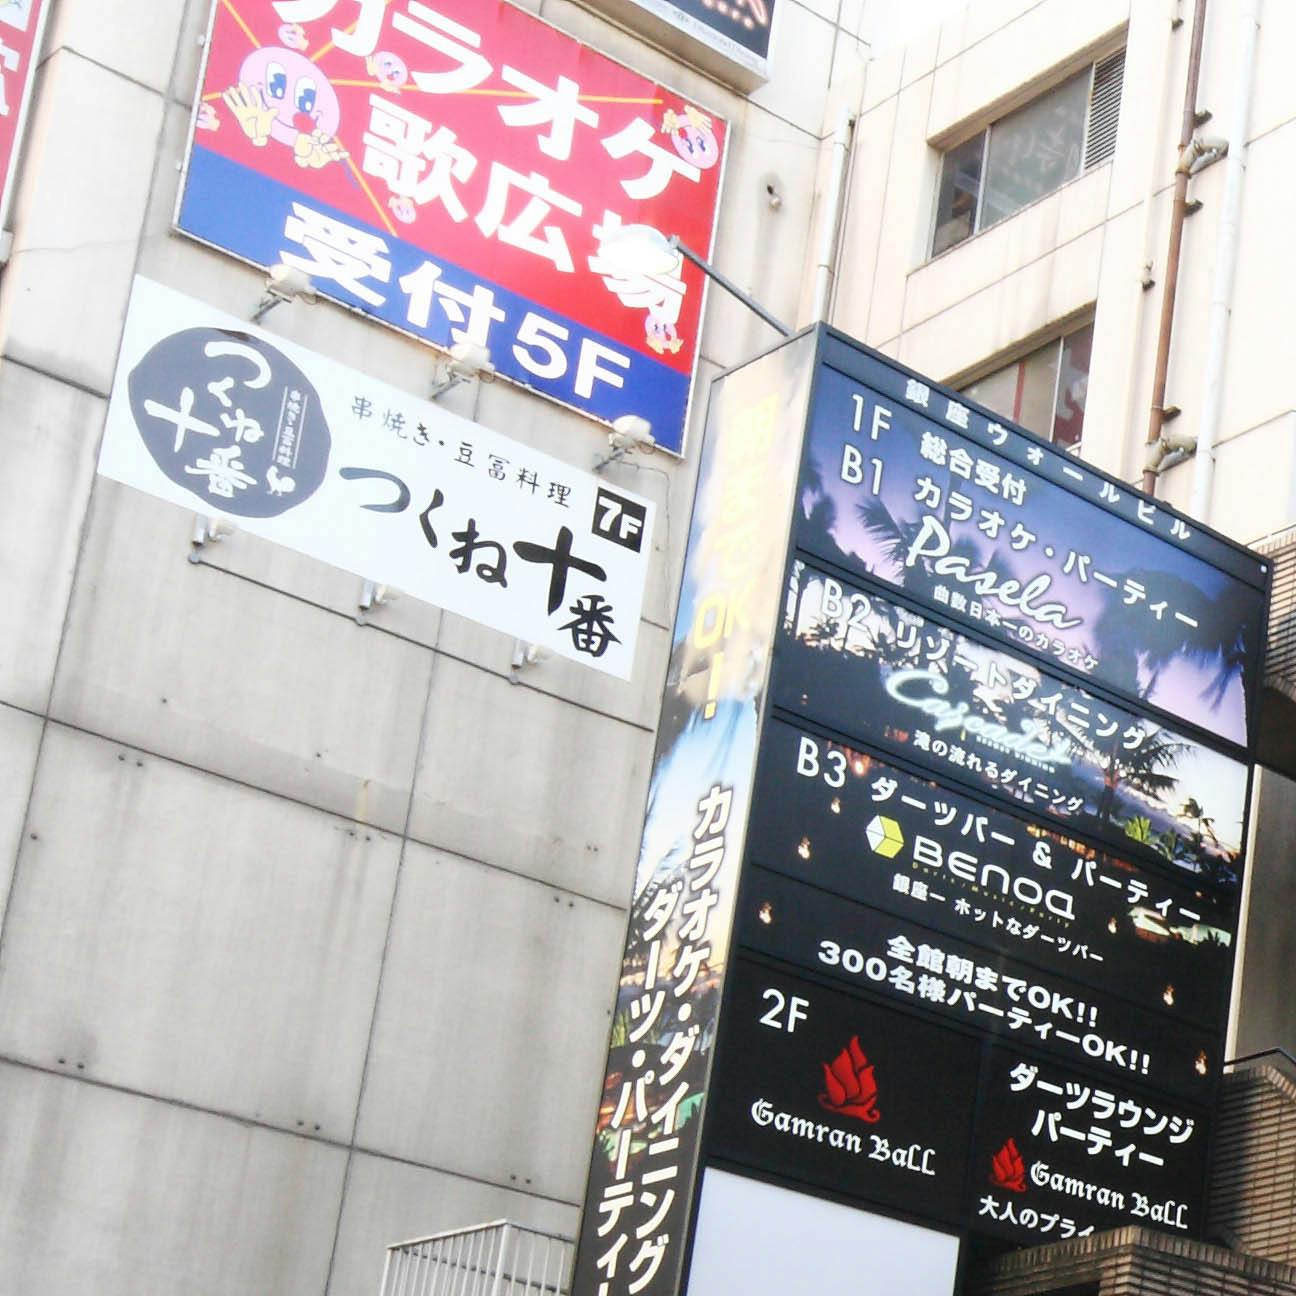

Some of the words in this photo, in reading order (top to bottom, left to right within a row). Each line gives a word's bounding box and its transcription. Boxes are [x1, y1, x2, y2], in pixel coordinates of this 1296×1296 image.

[851, 393, 893, 441] 1F
[840, 444, 885, 497] B1
[904, 378, 1192, 541] 銀座ウォールビル
[920, 431, 1027, 507] 総合受付
[597, 495, 642, 540] 7F
[914, 476, 1199, 629] カラオケ・パーティー
[339, 467, 622, 657] つくね十番
[906, 514, 1083, 632] Pasela
[820, 579, 872, 630] B2
[933, 584, 1099, 670] 曲数日本一のカラオケ
[895, 607, 1149, 751] リゾートダイニング
[796, 736, 848, 789] B3
[913, 730, 1084, 811] 滝の流れるダイニング
[871, 776, 1015, 847] ダーツバー
[1071, 857, 1201, 921] パーティー
[759, 988, 811, 1034] 2F
[817, 940, 1152, 1076] 300名様パーティーOK!!
[887, 935, 1099, 1028] 全館朝までOK!!
[628, 786, 733, 1295] カラオケ・ダイニング
[751, 1098, 862, 1155] Gamran
[1008, 1061, 1196, 1144] ダーツラウンジ
[1030, 1108, 1165, 1169] パーティー
[1029, 1159, 1127, 1211] Gamran
